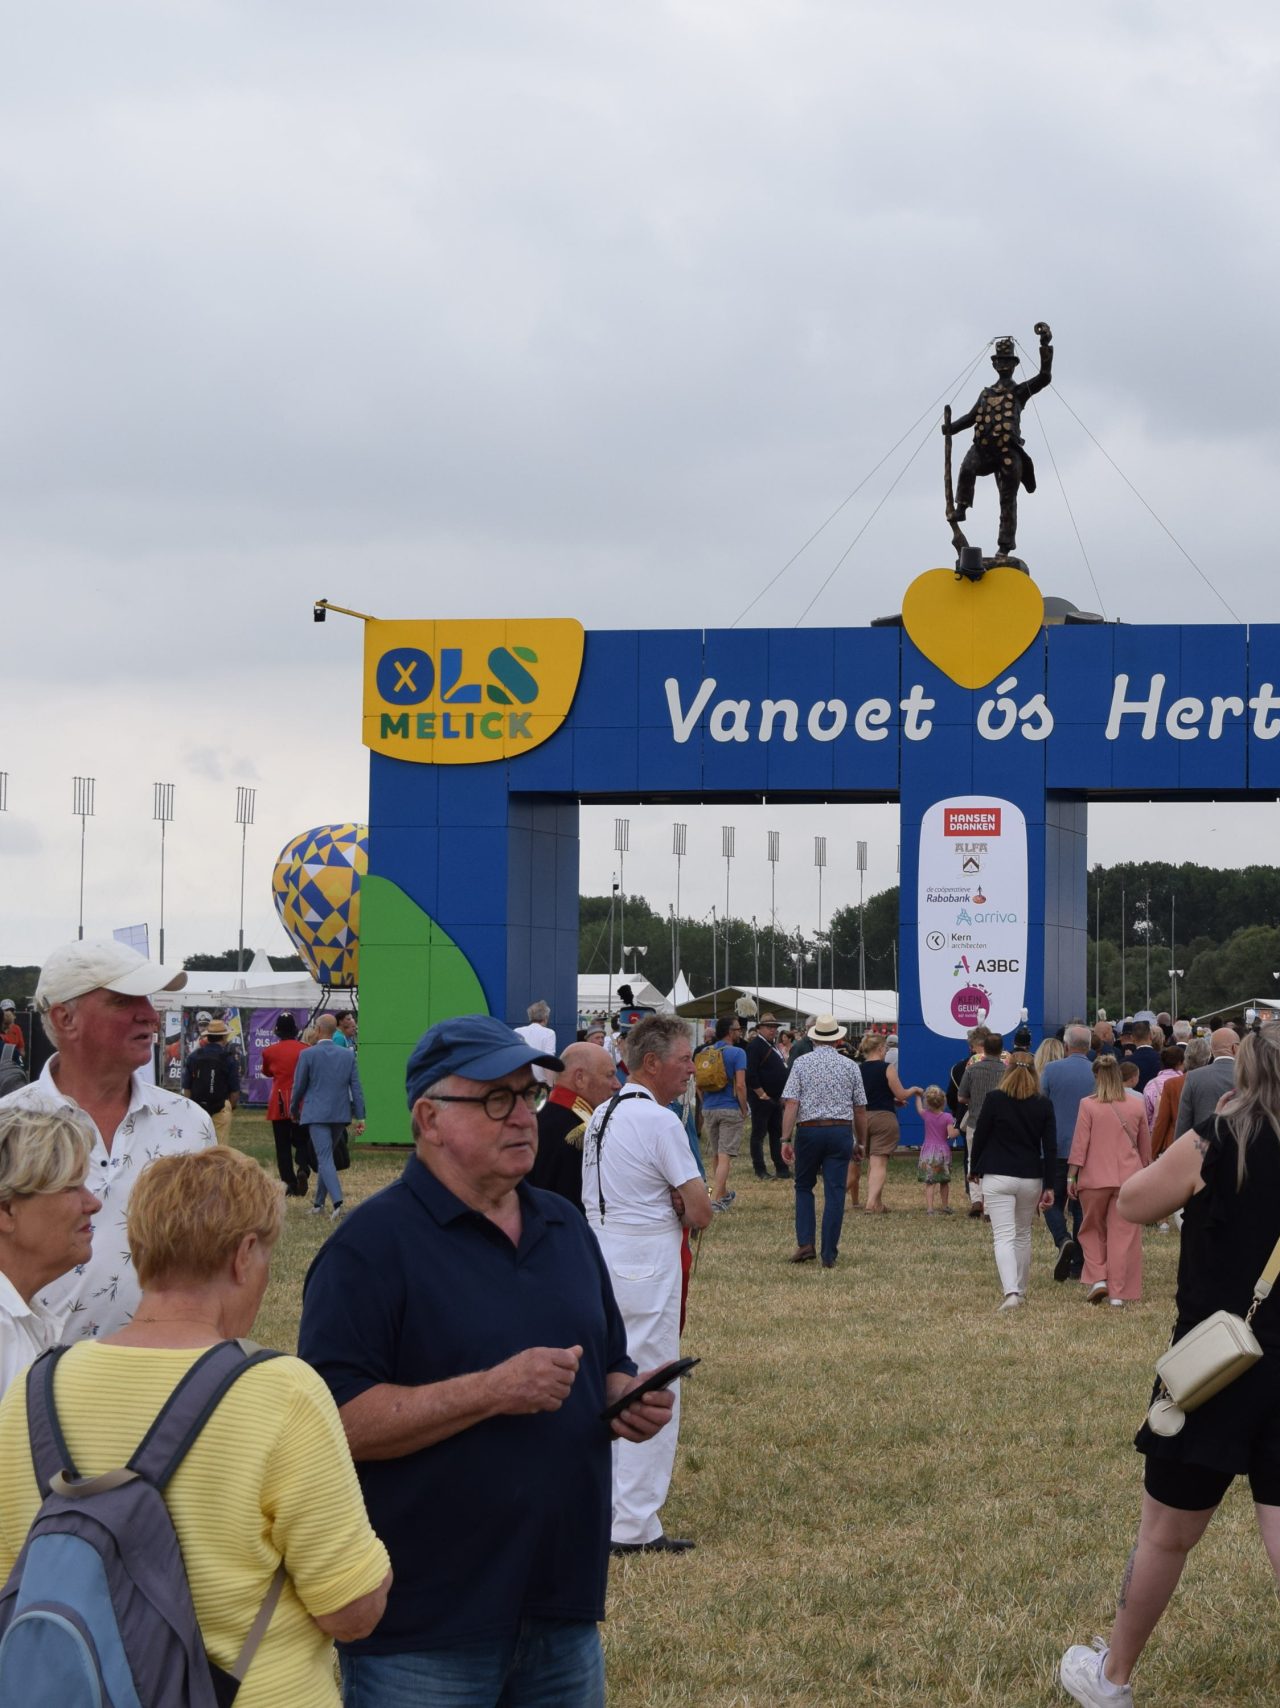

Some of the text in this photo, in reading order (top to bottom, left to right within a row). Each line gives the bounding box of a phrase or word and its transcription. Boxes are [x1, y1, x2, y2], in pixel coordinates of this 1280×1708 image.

[376, 647, 539, 705] OLS
[664, 677, 935, 743] Vanoet
[976, 676, 1054, 740] ós
[380, 712, 533, 739] MELICK
[949, 814, 995, 822] HANSEN
[949, 823, 995, 831] DRANKEN
[955, 843, 988, 852] ALFA
[926, 894, 970, 902] Rabobank
[974, 910, 1017, 923] arriva
[951, 933, 971, 941] Kern
[975, 960, 1019, 972] A3BC
[958, 996, 981, 1004] KLEIN
[255, 1038, 270, 1047] OLS
